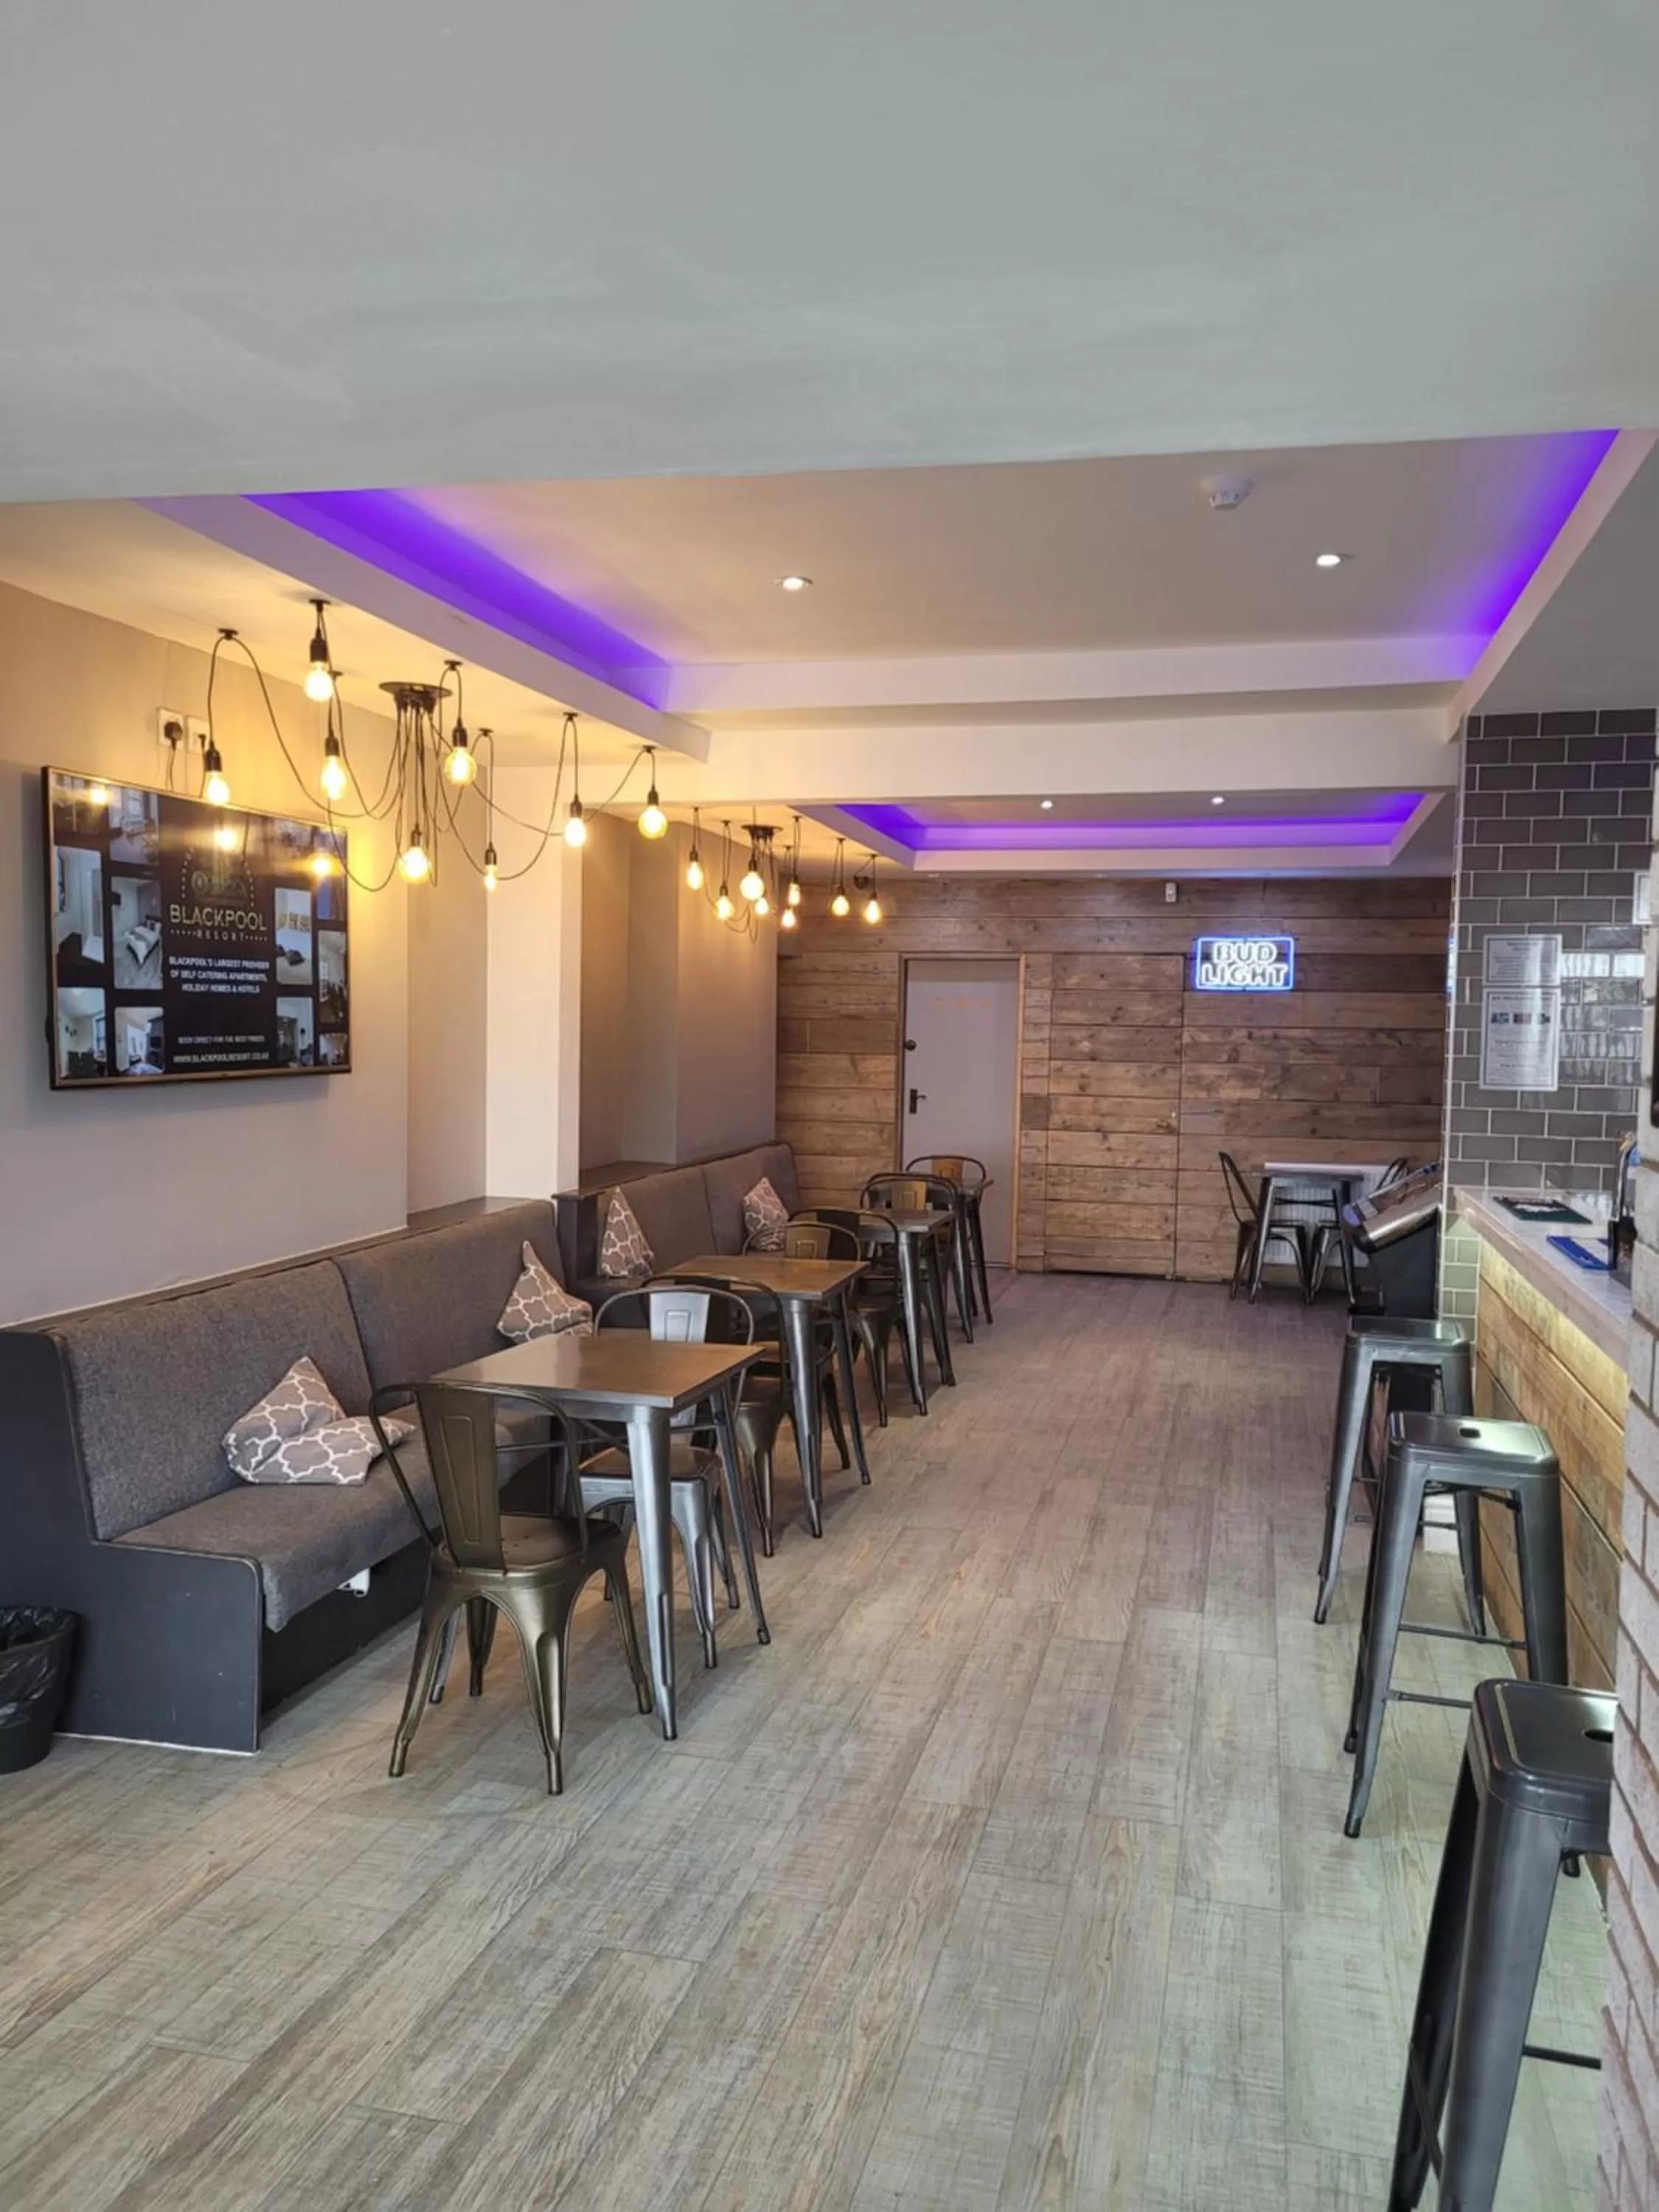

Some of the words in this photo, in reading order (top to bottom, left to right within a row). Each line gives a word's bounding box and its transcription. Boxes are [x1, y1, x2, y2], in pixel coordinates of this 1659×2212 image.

[170, 904, 267, 931] BLACKPOOL
[197, 929, 244, 941] RESORT
[1214, 942, 1277, 964] BUD
[1202, 963, 1288, 986] LIGHT
